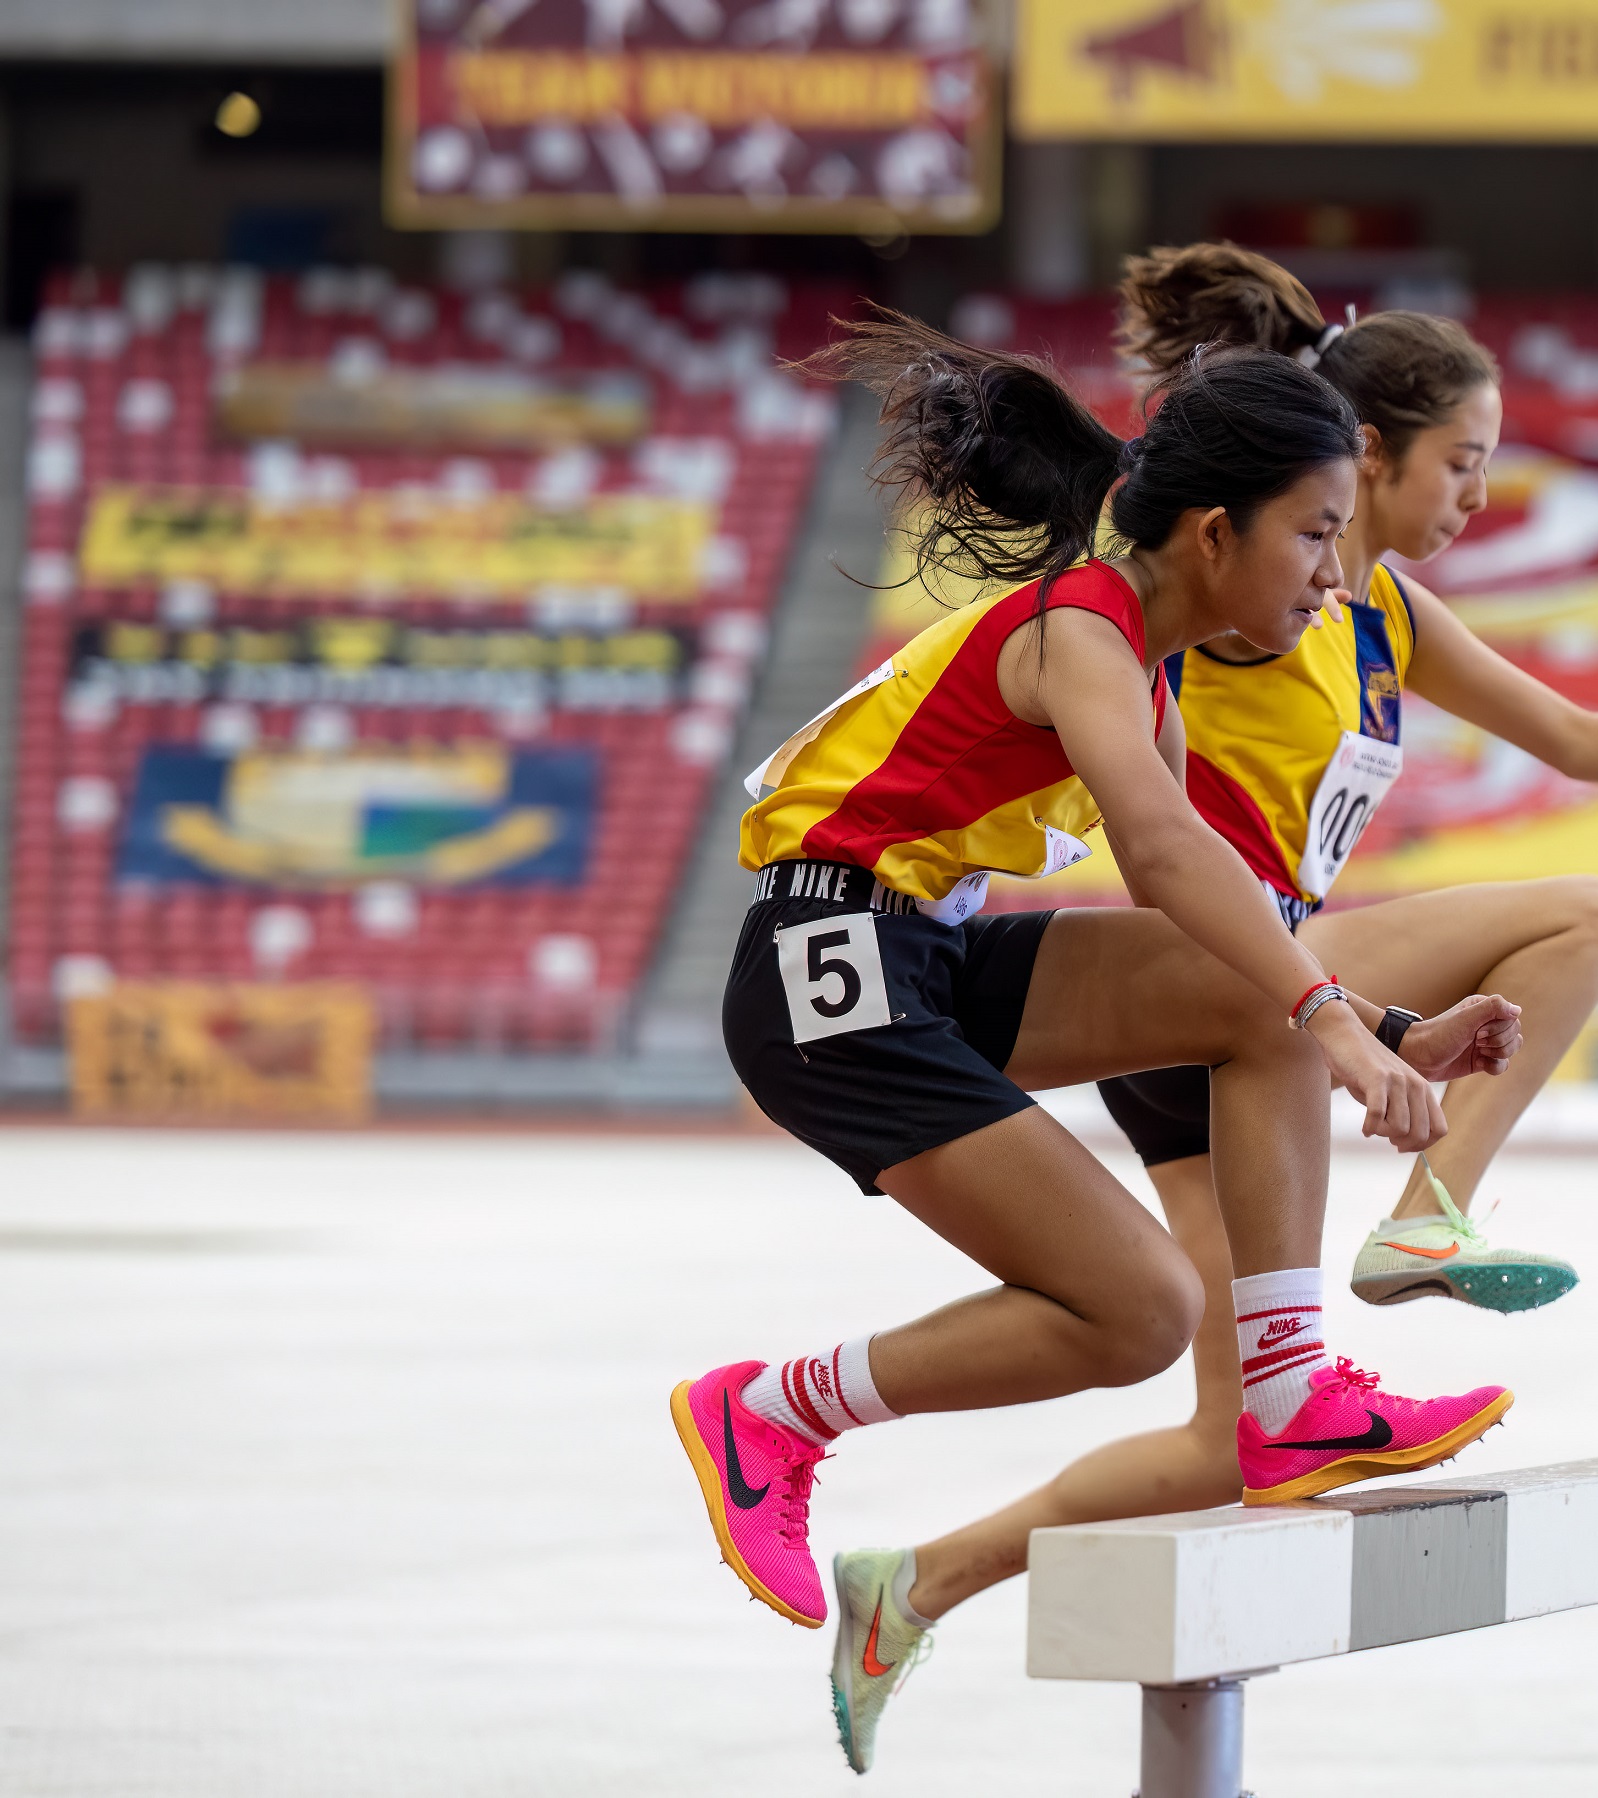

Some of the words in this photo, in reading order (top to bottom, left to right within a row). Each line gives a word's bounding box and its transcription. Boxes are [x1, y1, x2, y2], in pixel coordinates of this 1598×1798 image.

[1319, 788, 1378, 862] 00
[789, 864, 850, 902] NIKE
[807, 928, 861, 1018] 5
[1265, 1317, 1301, 1336] NIKE
[818, 1363, 834, 1398] NIKE
